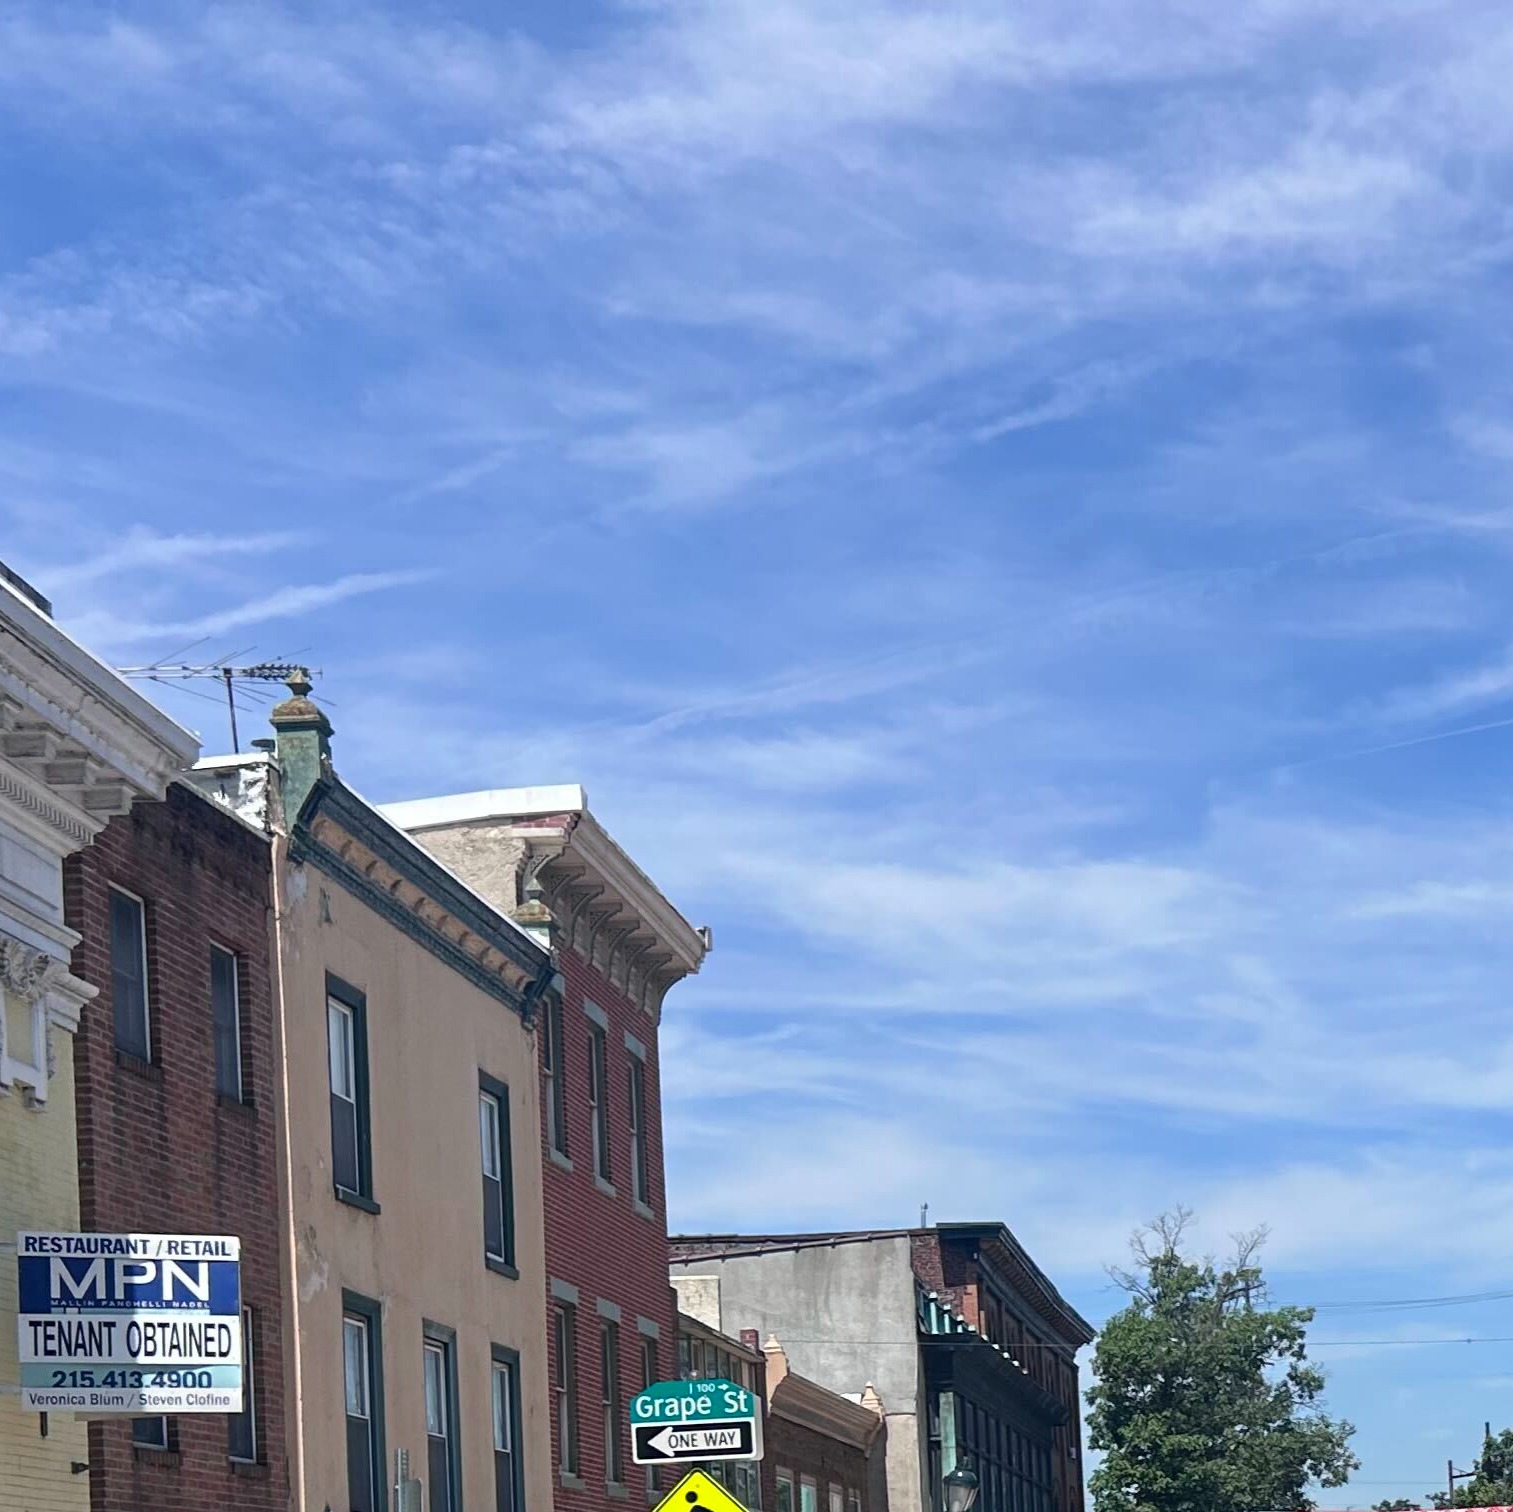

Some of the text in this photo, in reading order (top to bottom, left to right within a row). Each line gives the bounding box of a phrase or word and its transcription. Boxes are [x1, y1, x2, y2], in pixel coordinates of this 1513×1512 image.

[24, 1236, 150, 1255] RESTAURANT
[168, 1240, 231, 1256] RETAIL
[50, 1257, 210, 1301] MPN
[29, 1320, 232, 1358] TENANT OBTAINED
[51, 1370, 212, 1389] 215.413.4900
[697, 1383, 715, 1393] 100
[29, 1393, 85, 1406] Veronica
[91, 1393, 124, 1406] Blum
[139, 1394, 182, 1406] Steven
[186, 1393, 230, 1406] Clofine
[636, 1390, 748, 1421] Grape St
[668, 1431, 735, 1448] ONE WAY
